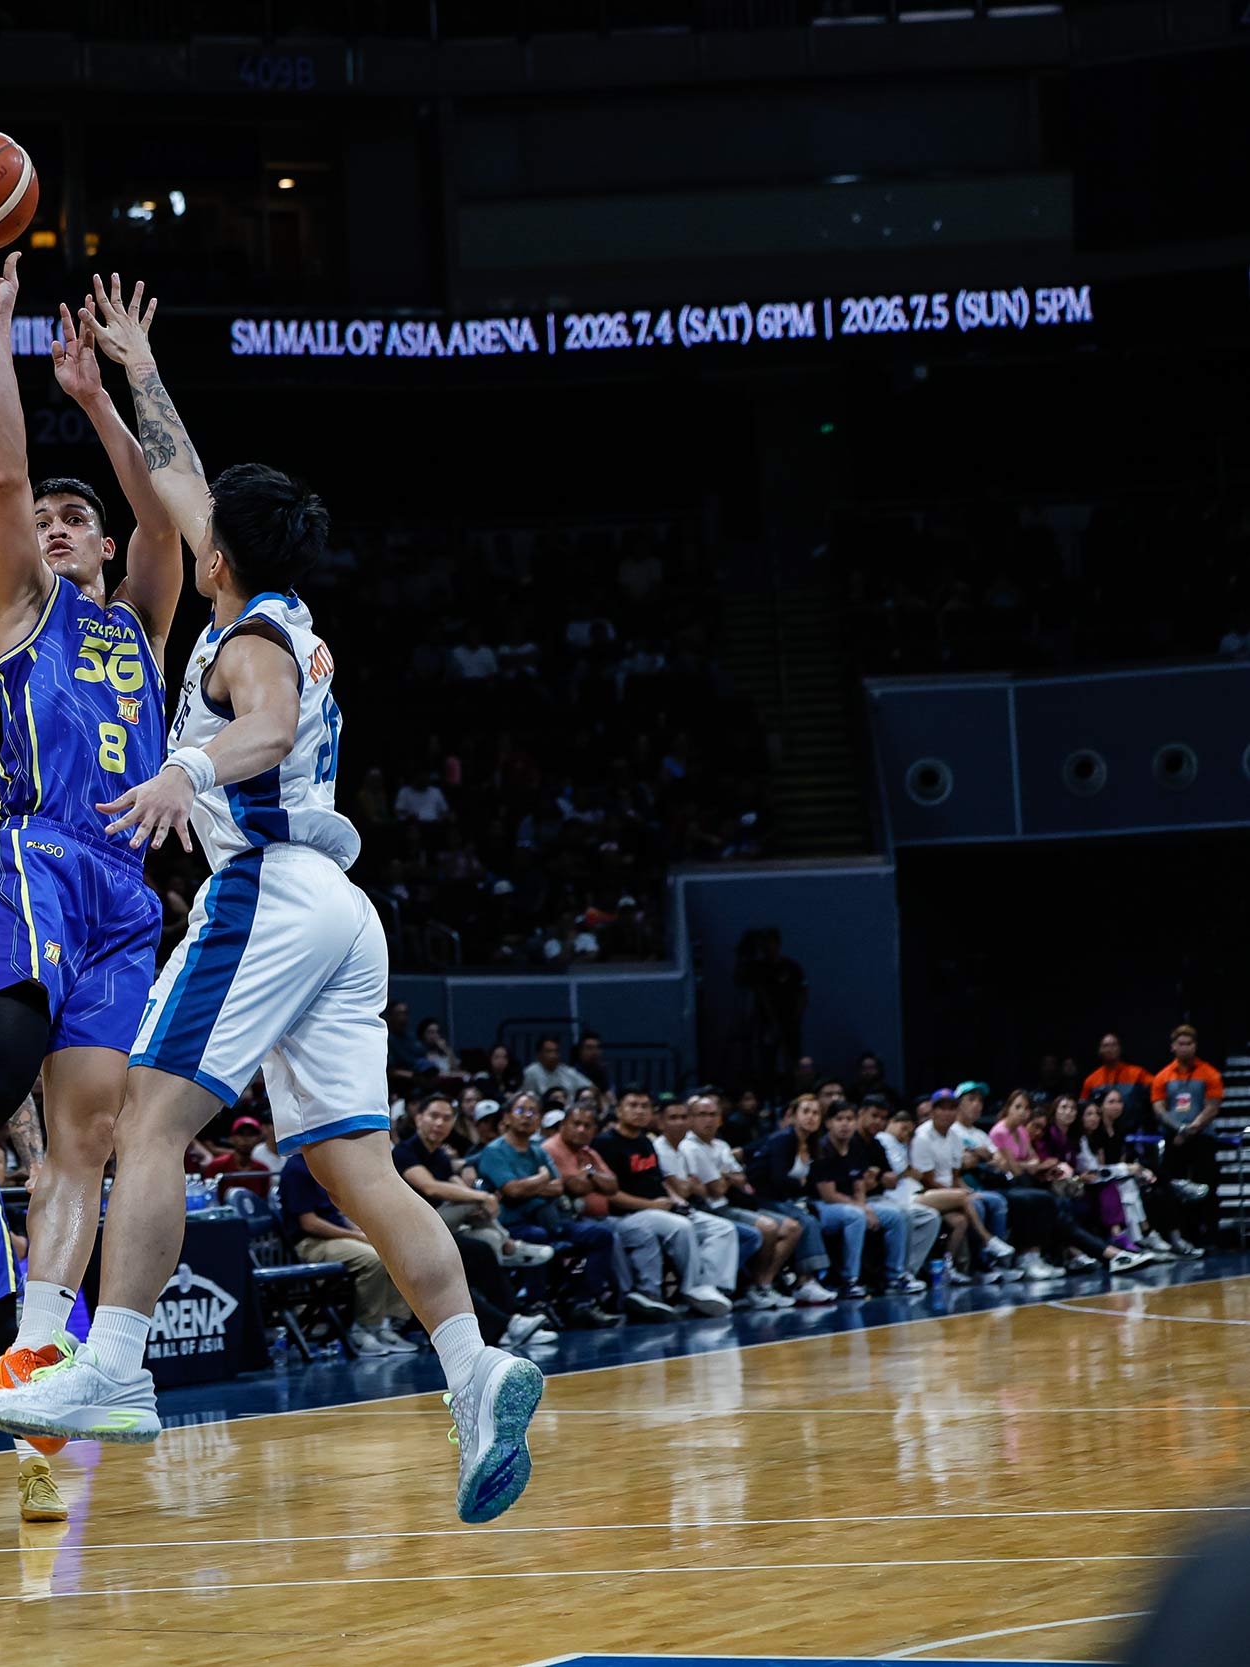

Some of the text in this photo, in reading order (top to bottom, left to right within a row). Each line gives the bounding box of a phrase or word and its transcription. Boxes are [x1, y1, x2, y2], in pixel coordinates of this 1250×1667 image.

[231, 319, 270, 355] SM
[273, 319, 345, 356] MALL
[345, 320, 384, 355] OF
[384, 321, 448, 357] ASIA
[446, 316, 539, 357] ARENA
[563, 310, 675, 350] 2026.7.4
[678, 302, 752, 347] (SAT)
[756, 302, 817, 340] 6PM
[841, 293, 950, 335] 2026.7.5
[955, 286, 1030, 333] (SUN)
[1035, 284, 1093, 324] 5PM
[32, 407, 98, 447] 20
[77, 618, 136, 640] TROPAN
[74, 635, 144, 693] 5G
[99, 721, 127, 774] 8
[148, 1297, 227, 1341] ARENA
[180, 1340, 196, 1356] OF
